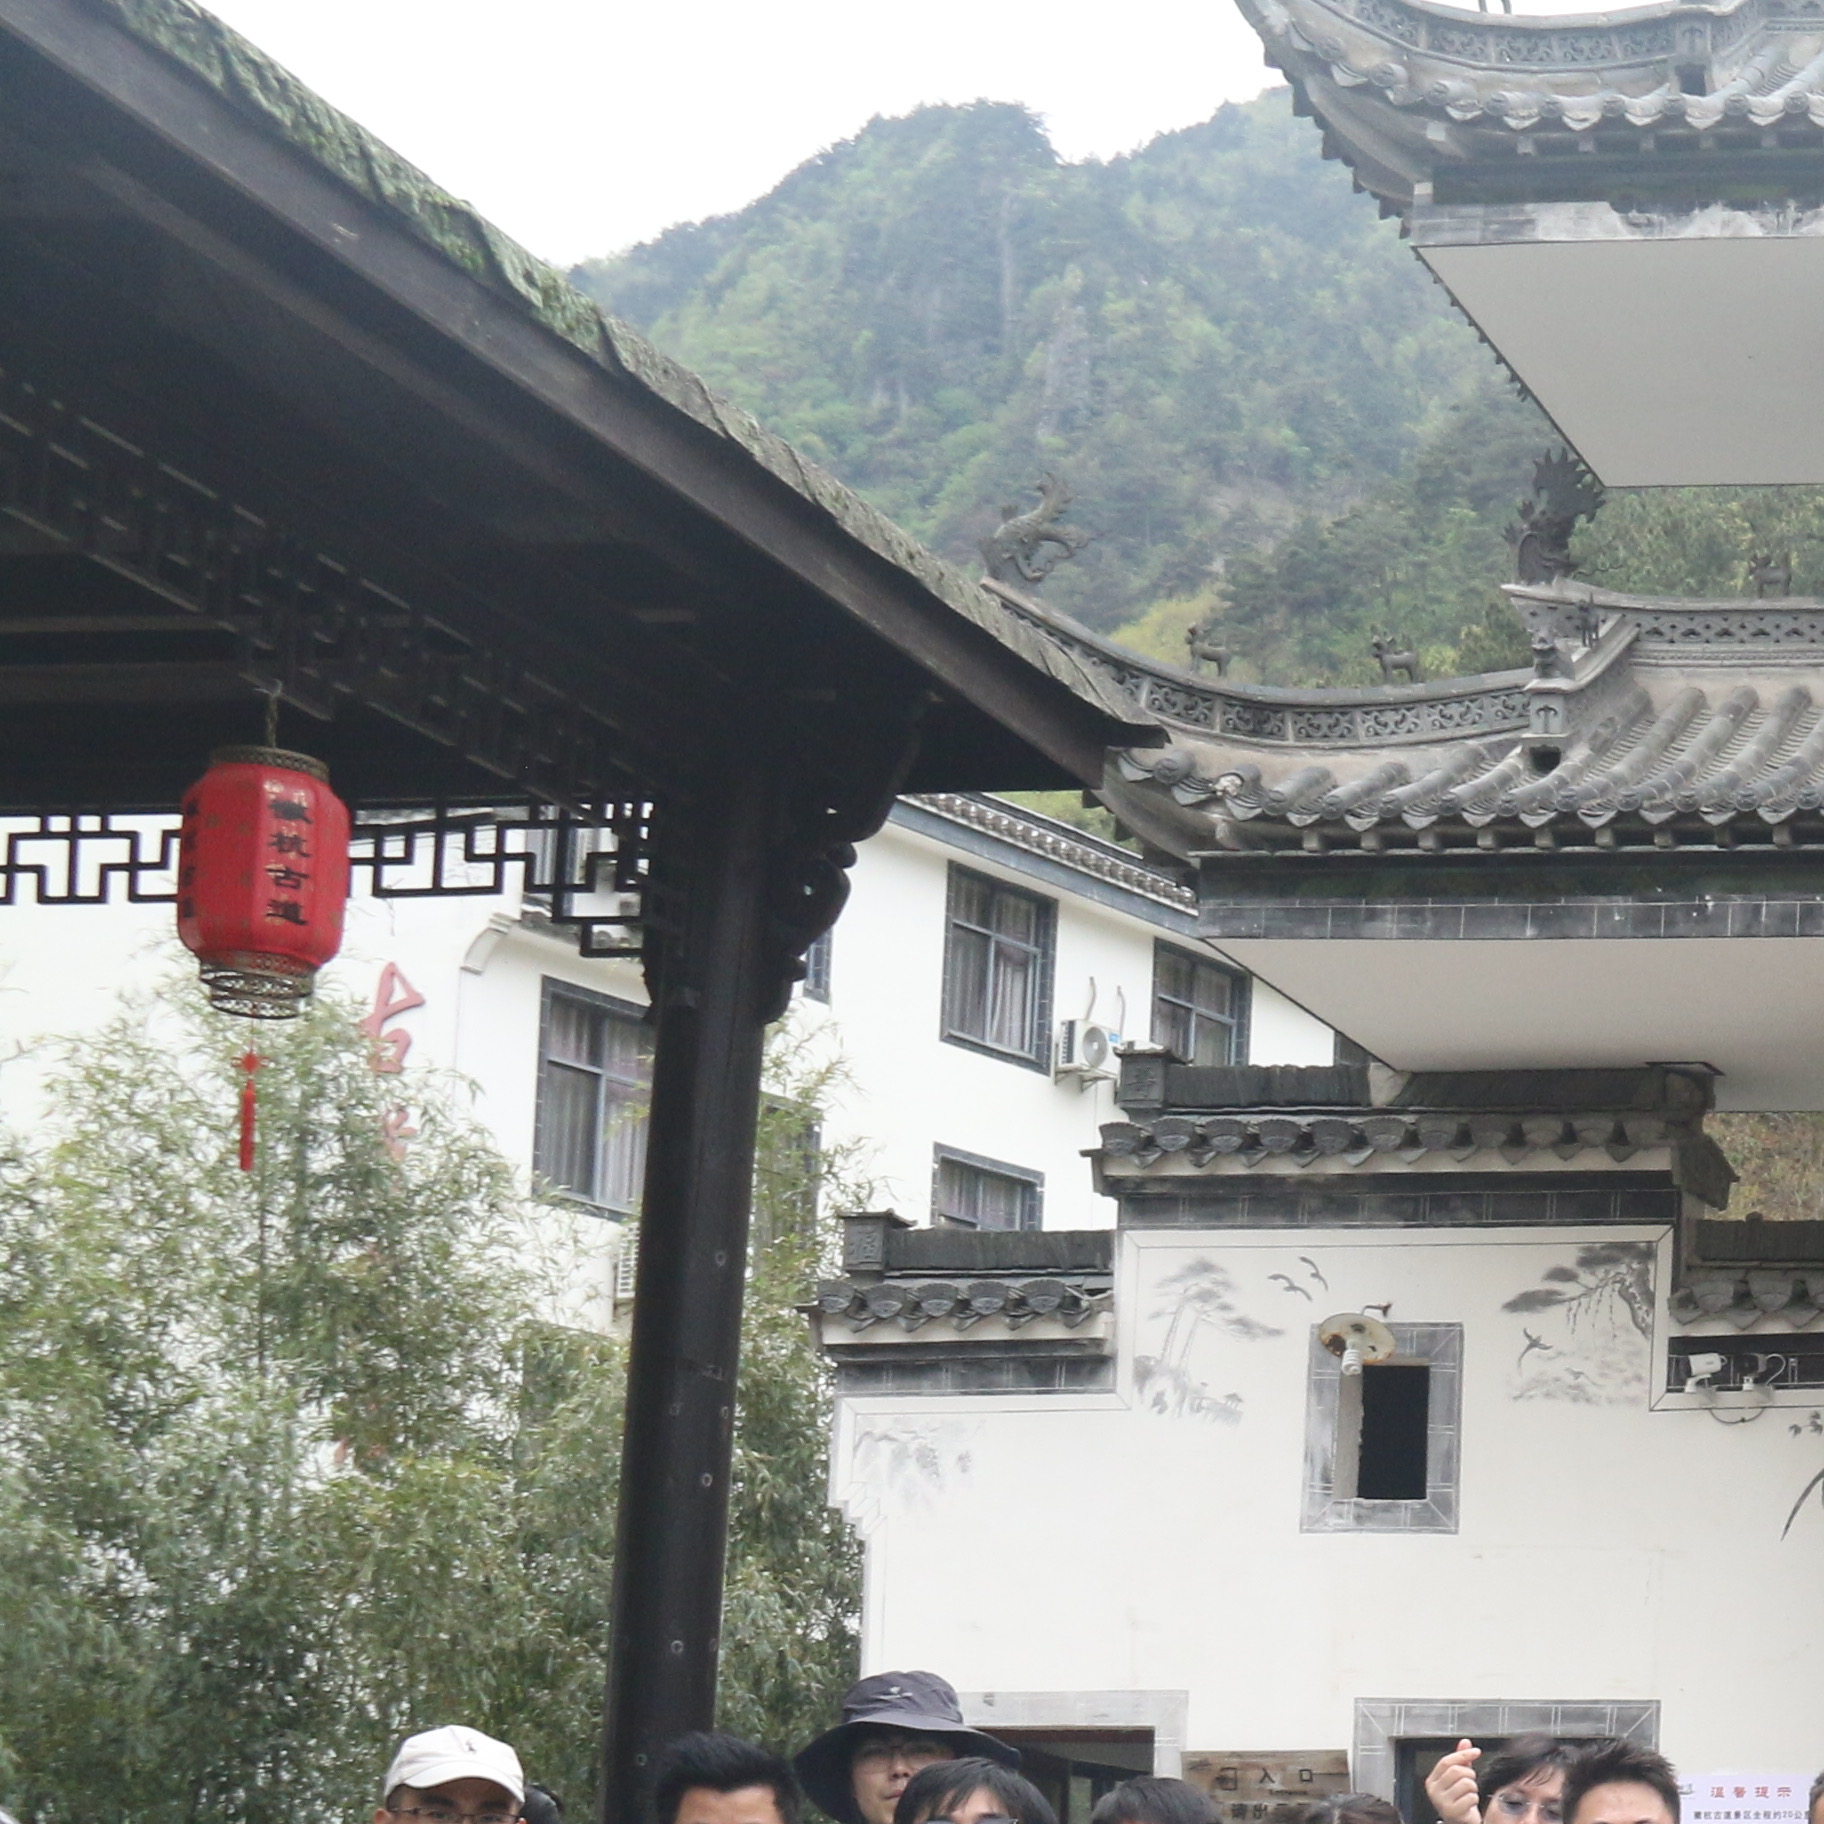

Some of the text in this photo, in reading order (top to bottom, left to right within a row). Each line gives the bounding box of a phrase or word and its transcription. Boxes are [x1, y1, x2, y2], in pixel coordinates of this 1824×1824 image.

[1258, 1768, 1314, 1783] 入口
[1710, 1786, 1793, 1799] 温馨提示
